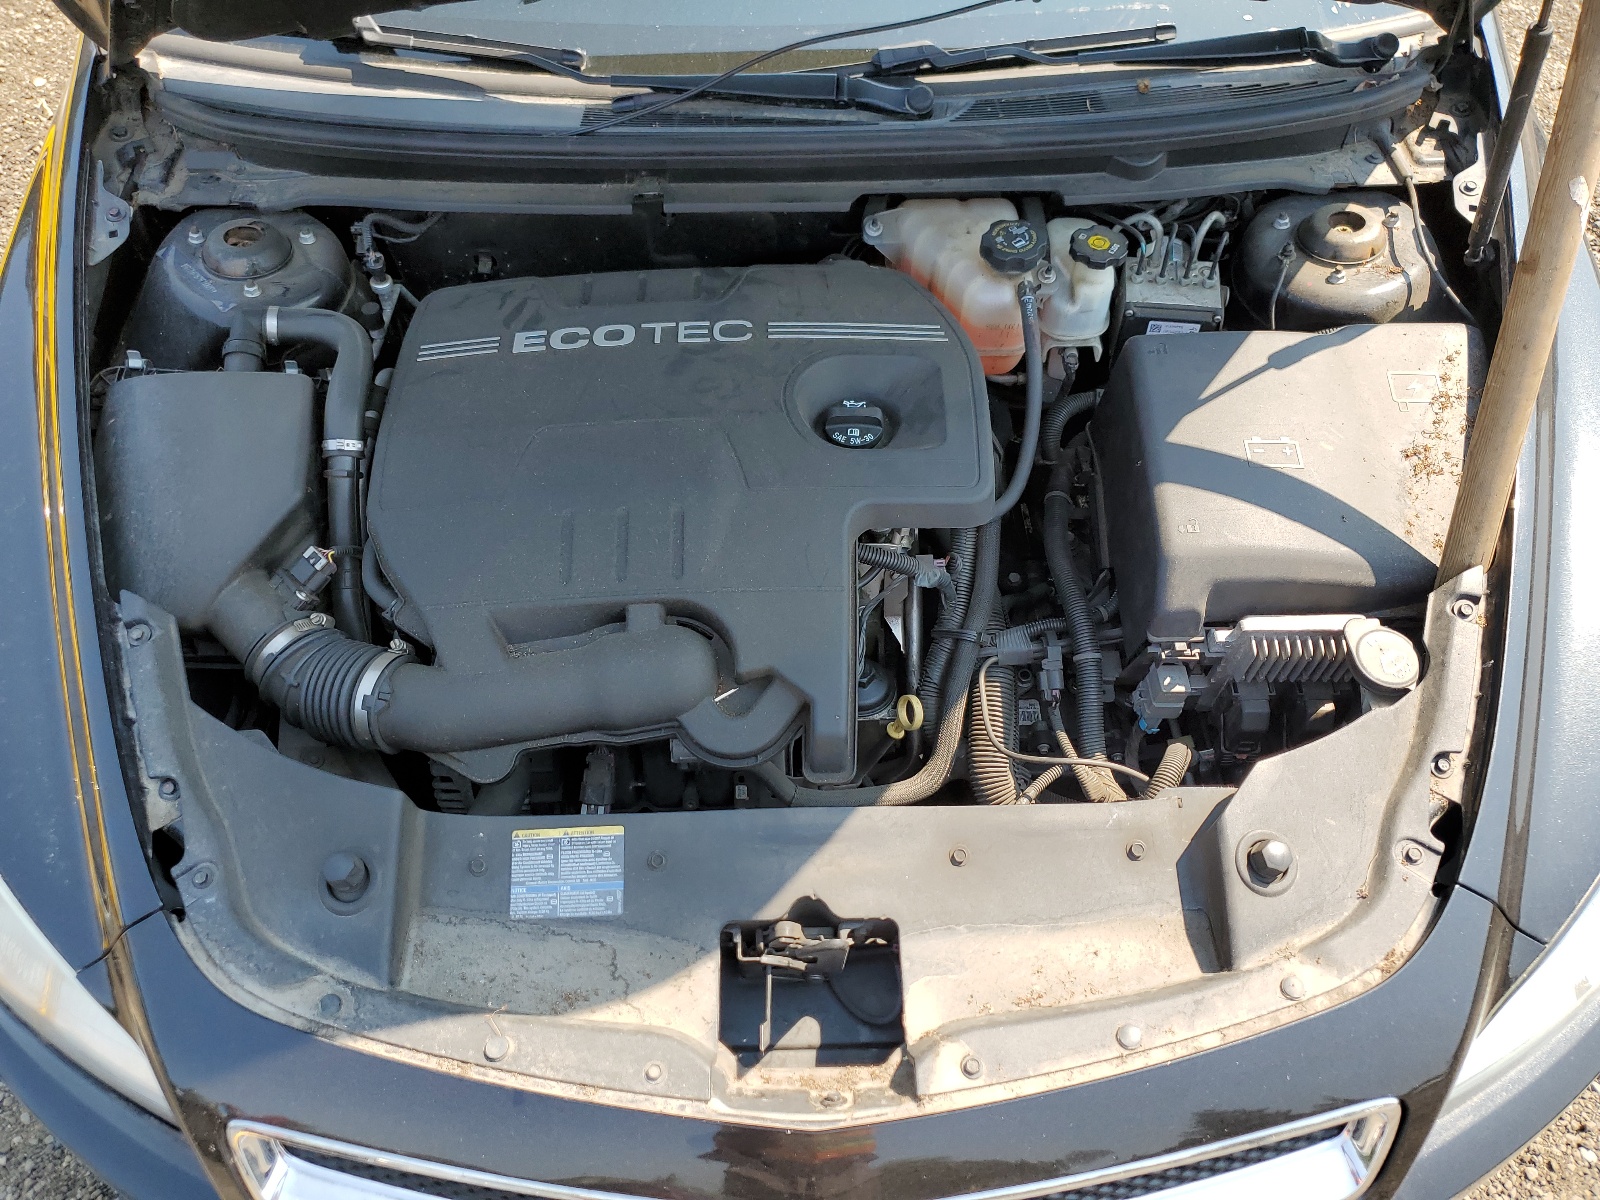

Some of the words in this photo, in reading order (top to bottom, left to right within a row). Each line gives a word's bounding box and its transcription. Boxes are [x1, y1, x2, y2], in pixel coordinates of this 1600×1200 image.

[512, 320, 753, 354] ECOTEC
[832, 432, 847, 443] SAE
[850, 433, 874, 445] 5W-30
